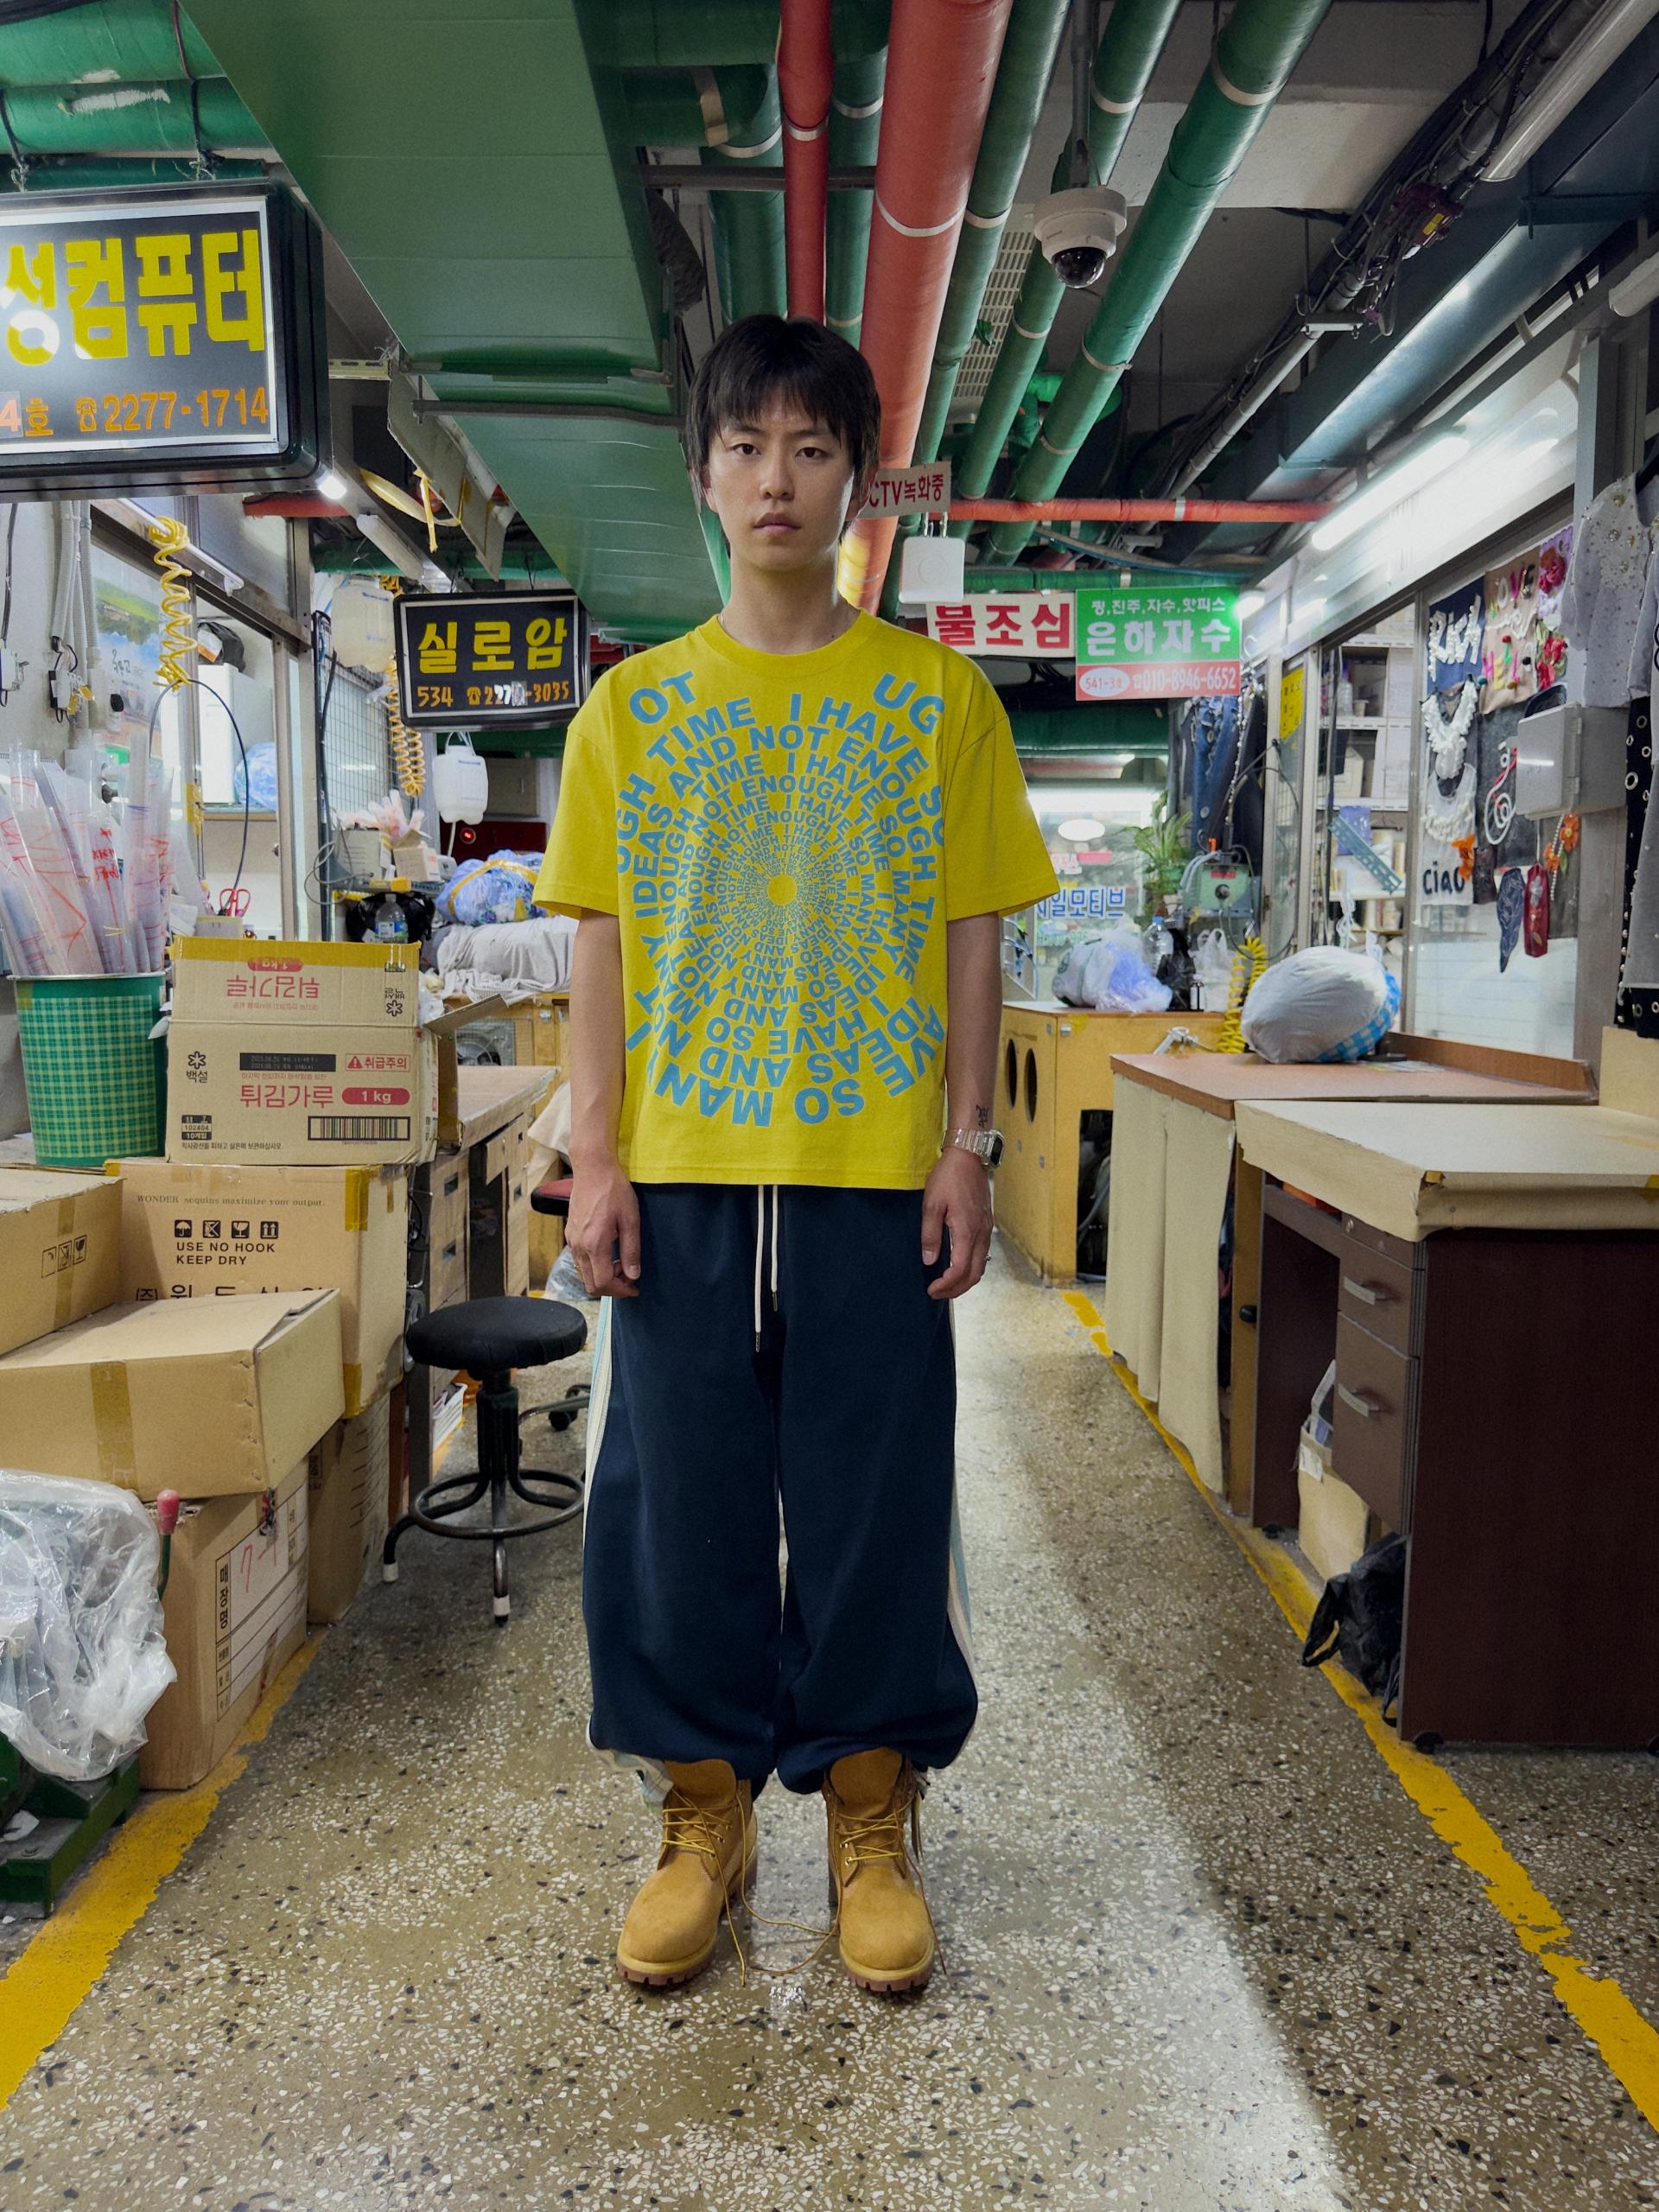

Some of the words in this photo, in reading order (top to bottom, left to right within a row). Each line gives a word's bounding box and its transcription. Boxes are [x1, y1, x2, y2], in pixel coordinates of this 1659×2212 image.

[103, 386, 269, 433] 2277-1714
[417, 617, 568, 674] 실로암
[934, 603, 1071, 649] 불조심
[1086, 619, 1231, 657] 은하자수
[416, 686, 454, 708] 534
[1143, 667, 1236, 691] 010-8946-6652
[646, 697, 756, 766] TIME
[749, 724, 830, 751] NOT
[790, 693, 802, 721] I
[817, 696, 928, 782] HAVE
[669, 736, 736, 798] AND
[690, 753, 763, 800] TIME
[787, 752, 796, 772] I
[806, 753, 884, 810] HAVE
[683, 788, 733, 836] NOT
[717, 796, 769, 828] TIME
[741, 774, 853, 810] ENOUGH
[837, 736, 936, 880] ENOUGH
[754, 810, 830, 835] ENOUGH
[798, 796, 851, 836] HAVE
[718, 821, 747, 853] NOT
[833, 833, 857, 875] TIME
[849, 836, 870, 866] SO
[855, 808, 889, 871] TIME
[879, 815, 906, 858] SO
[632, 804, 673, 918] IDEAS
[688, 830, 720, 926] ENOUGH
[704, 856, 722, 895] AND
[825, 903, 857, 949] HAVE
[852, 874, 875, 939] MANY
[882, 870, 911, 962] MANY
[671, 907, 721, 980] IDEAS
[706, 903, 739, 951] IDEAS
[844, 909, 891, 976] HAVE
[894, 897, 935, 979] TIME
[698, 935, 737, 969] NOT
[743, 951, 793, 969] MANY
[794, 942, 853, 982] IDEAS
[800, 944, 823, 964] SO
[226, 975, 320, 999] 튀김가루
[384, 987, 405, 1000] 백설
[663, 952, 718, 1006] NOT
[723, 976, 798, 1004] MANY
[742, 965, 786, 985] AND
[799, 964, 885, 1024] IDEAS
[808, 972, 842, 998] SO
[723, 998, 788, 1027] AND
[868, 994, 890, 1017] I
[706, 1016, 754, 1051] SO
[769, 1009, 868, 1055] HAVE
[807, 997, 937, 1084] IDEAS
[186, 1071, 208, 1084] 백설
[364, 1056, 407, 1070] 취급주의
[699, 1046, 791, 1088] AND
[240, 1084, 334, 1109] 튀김가루
[361, 1090, 368, 1103] 1
[373, 1090, 391, 1104] kg
[794, 1078, 865, 1124] SO
[137, 1195, 179, 1204] WONDER
[184, 1197, 219, 1206] sequins
[176, 1242, 204, 1252] USE
[210, 1243, 229, 1252] NO
[235, 1243, 276, 1253] HOOK
[176, 1255, 213, 1265] KEEP
[219, 1255, 247, 1266] DRY
